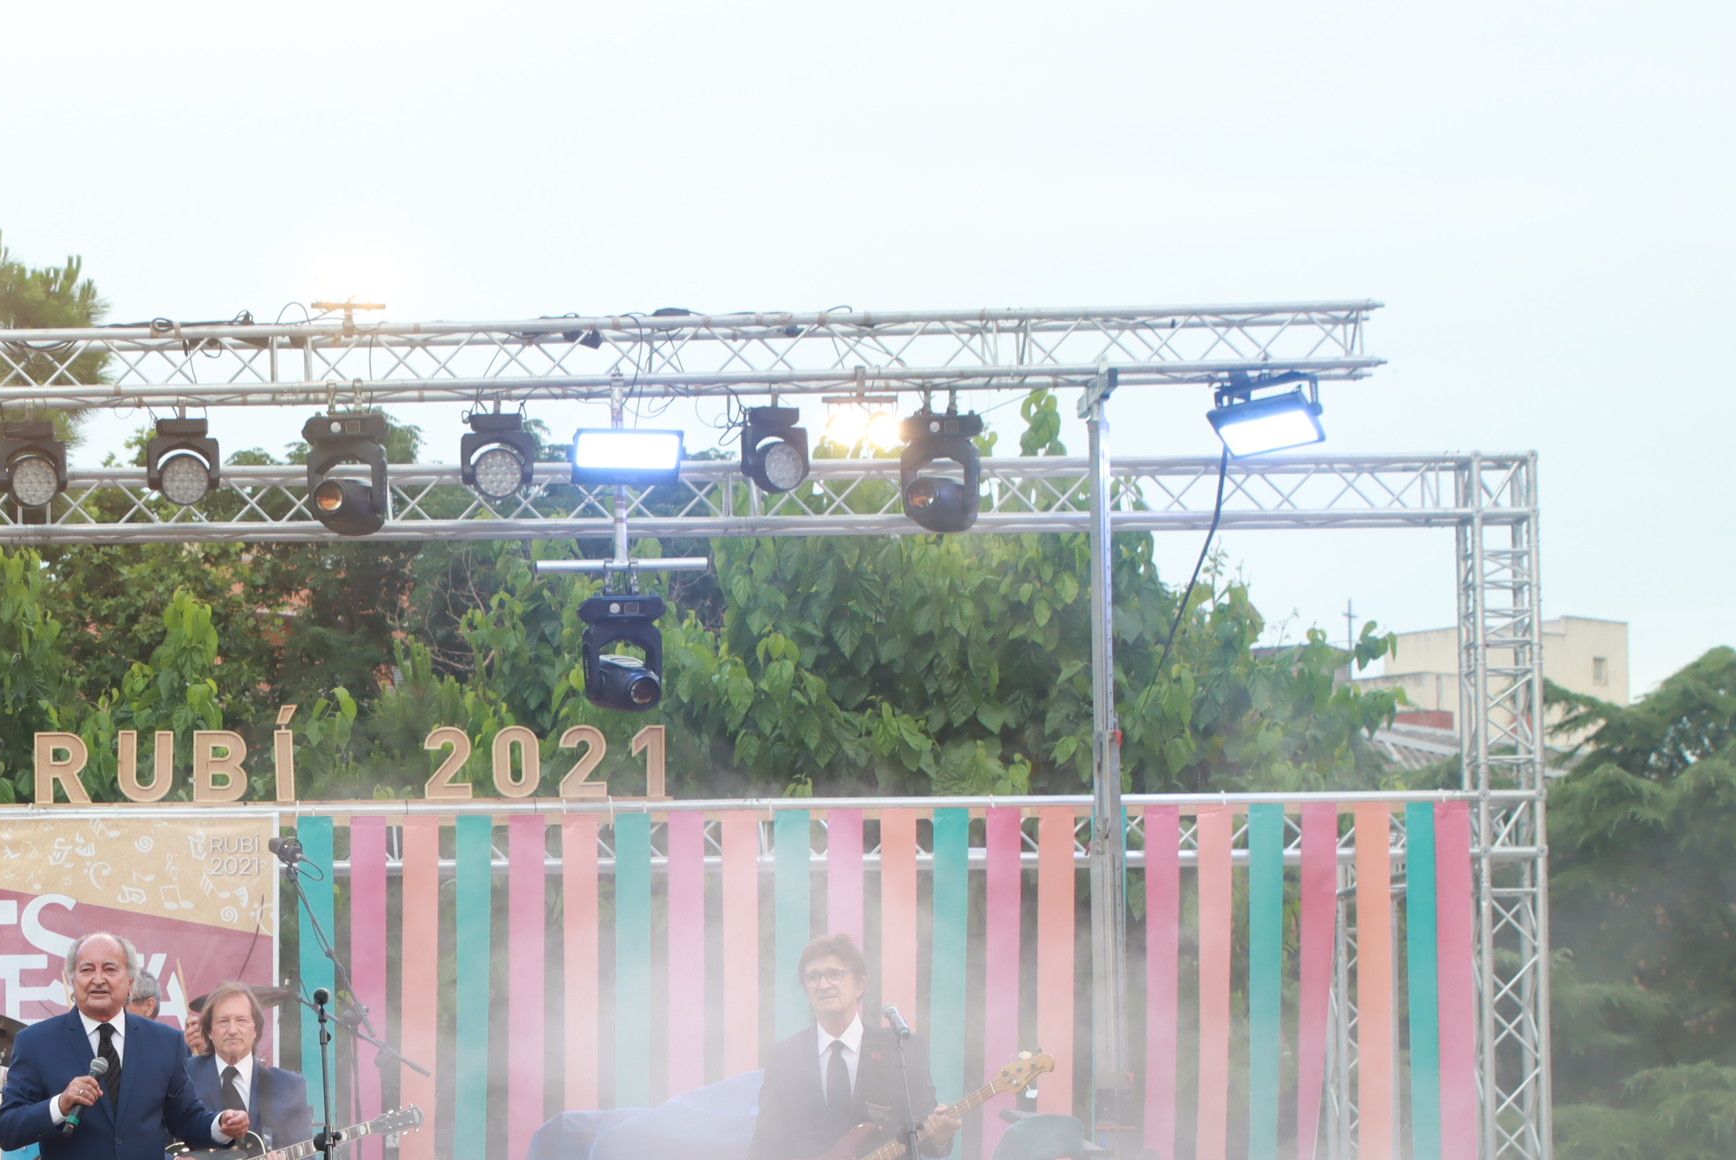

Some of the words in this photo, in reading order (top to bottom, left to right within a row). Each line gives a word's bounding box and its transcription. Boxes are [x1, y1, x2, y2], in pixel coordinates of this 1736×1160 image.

[33, 703, 299, 805] RUBÍ
[423, 723, 667, 800] 2021
[210, 832, 259, 854] RUBÍ
[210, 855, 260, 876] 2021
